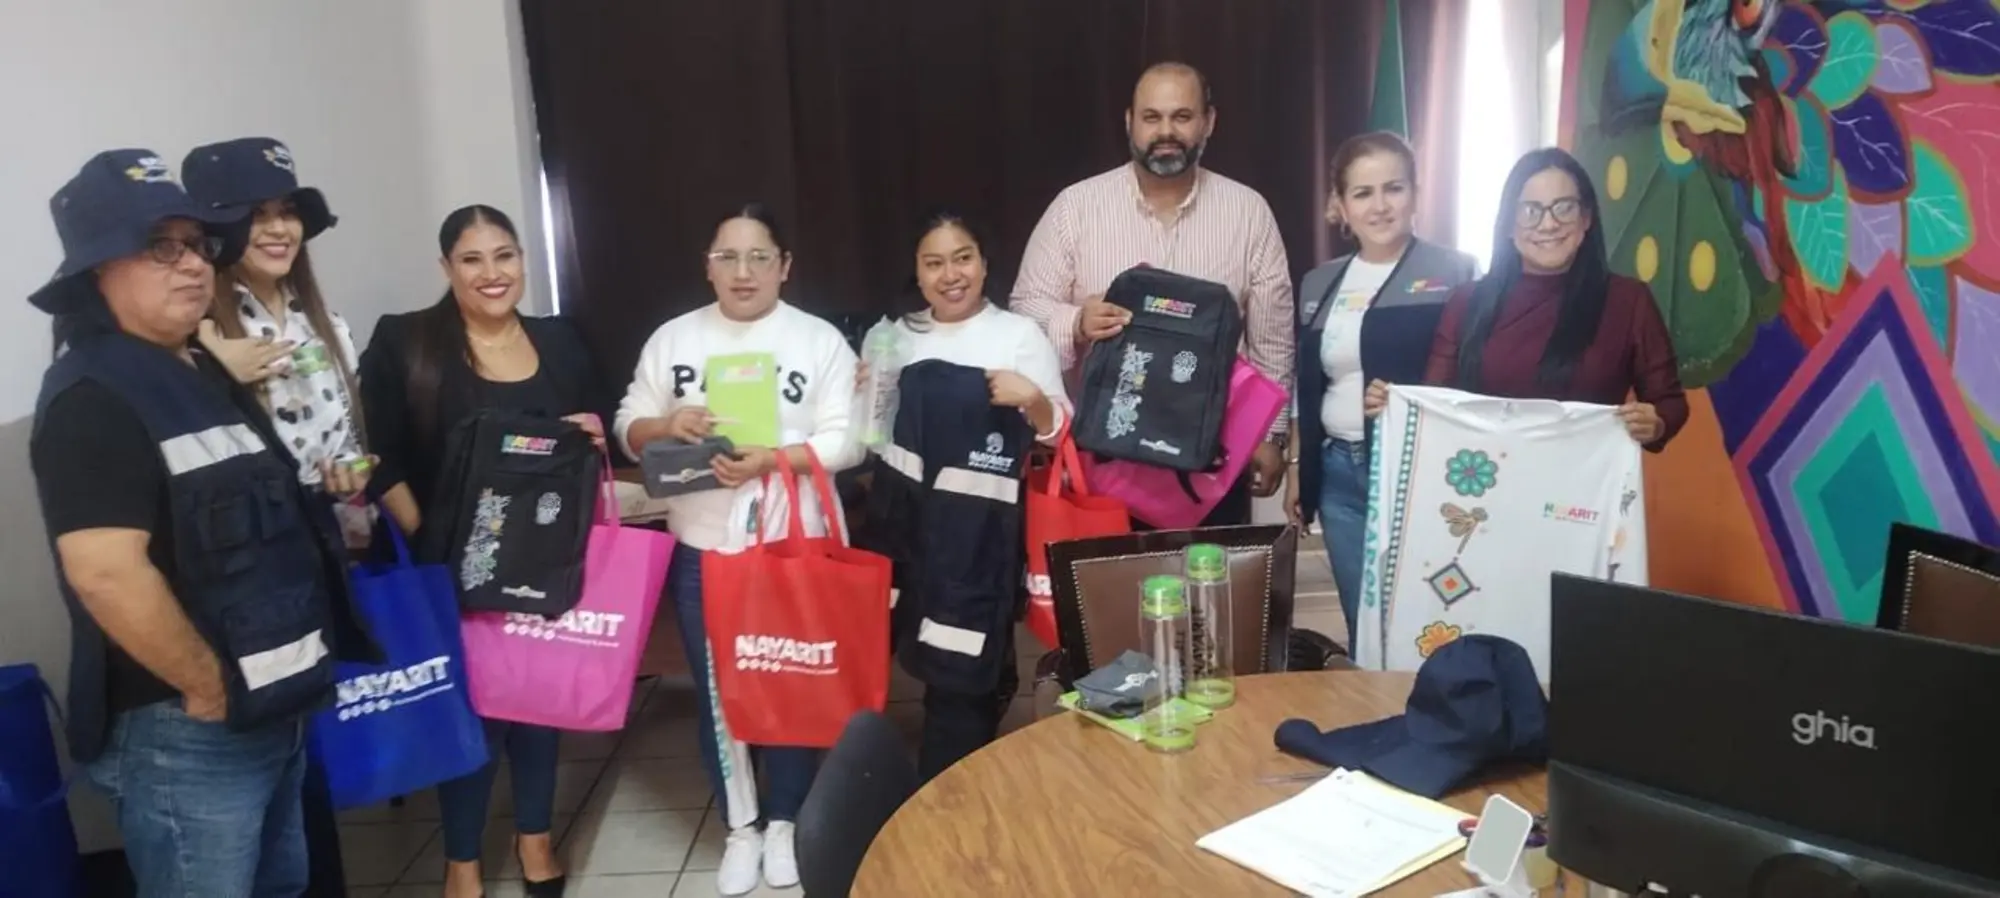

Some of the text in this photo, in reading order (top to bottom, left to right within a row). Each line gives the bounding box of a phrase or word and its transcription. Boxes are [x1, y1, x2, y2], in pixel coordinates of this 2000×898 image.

[1544, 501, 1599, 521] NARIT
[735, 634, 838, 666] NAYARIT
[335, 655, 451, 708] NAYARIT
[1791, 709, 1875, 748] ghia
